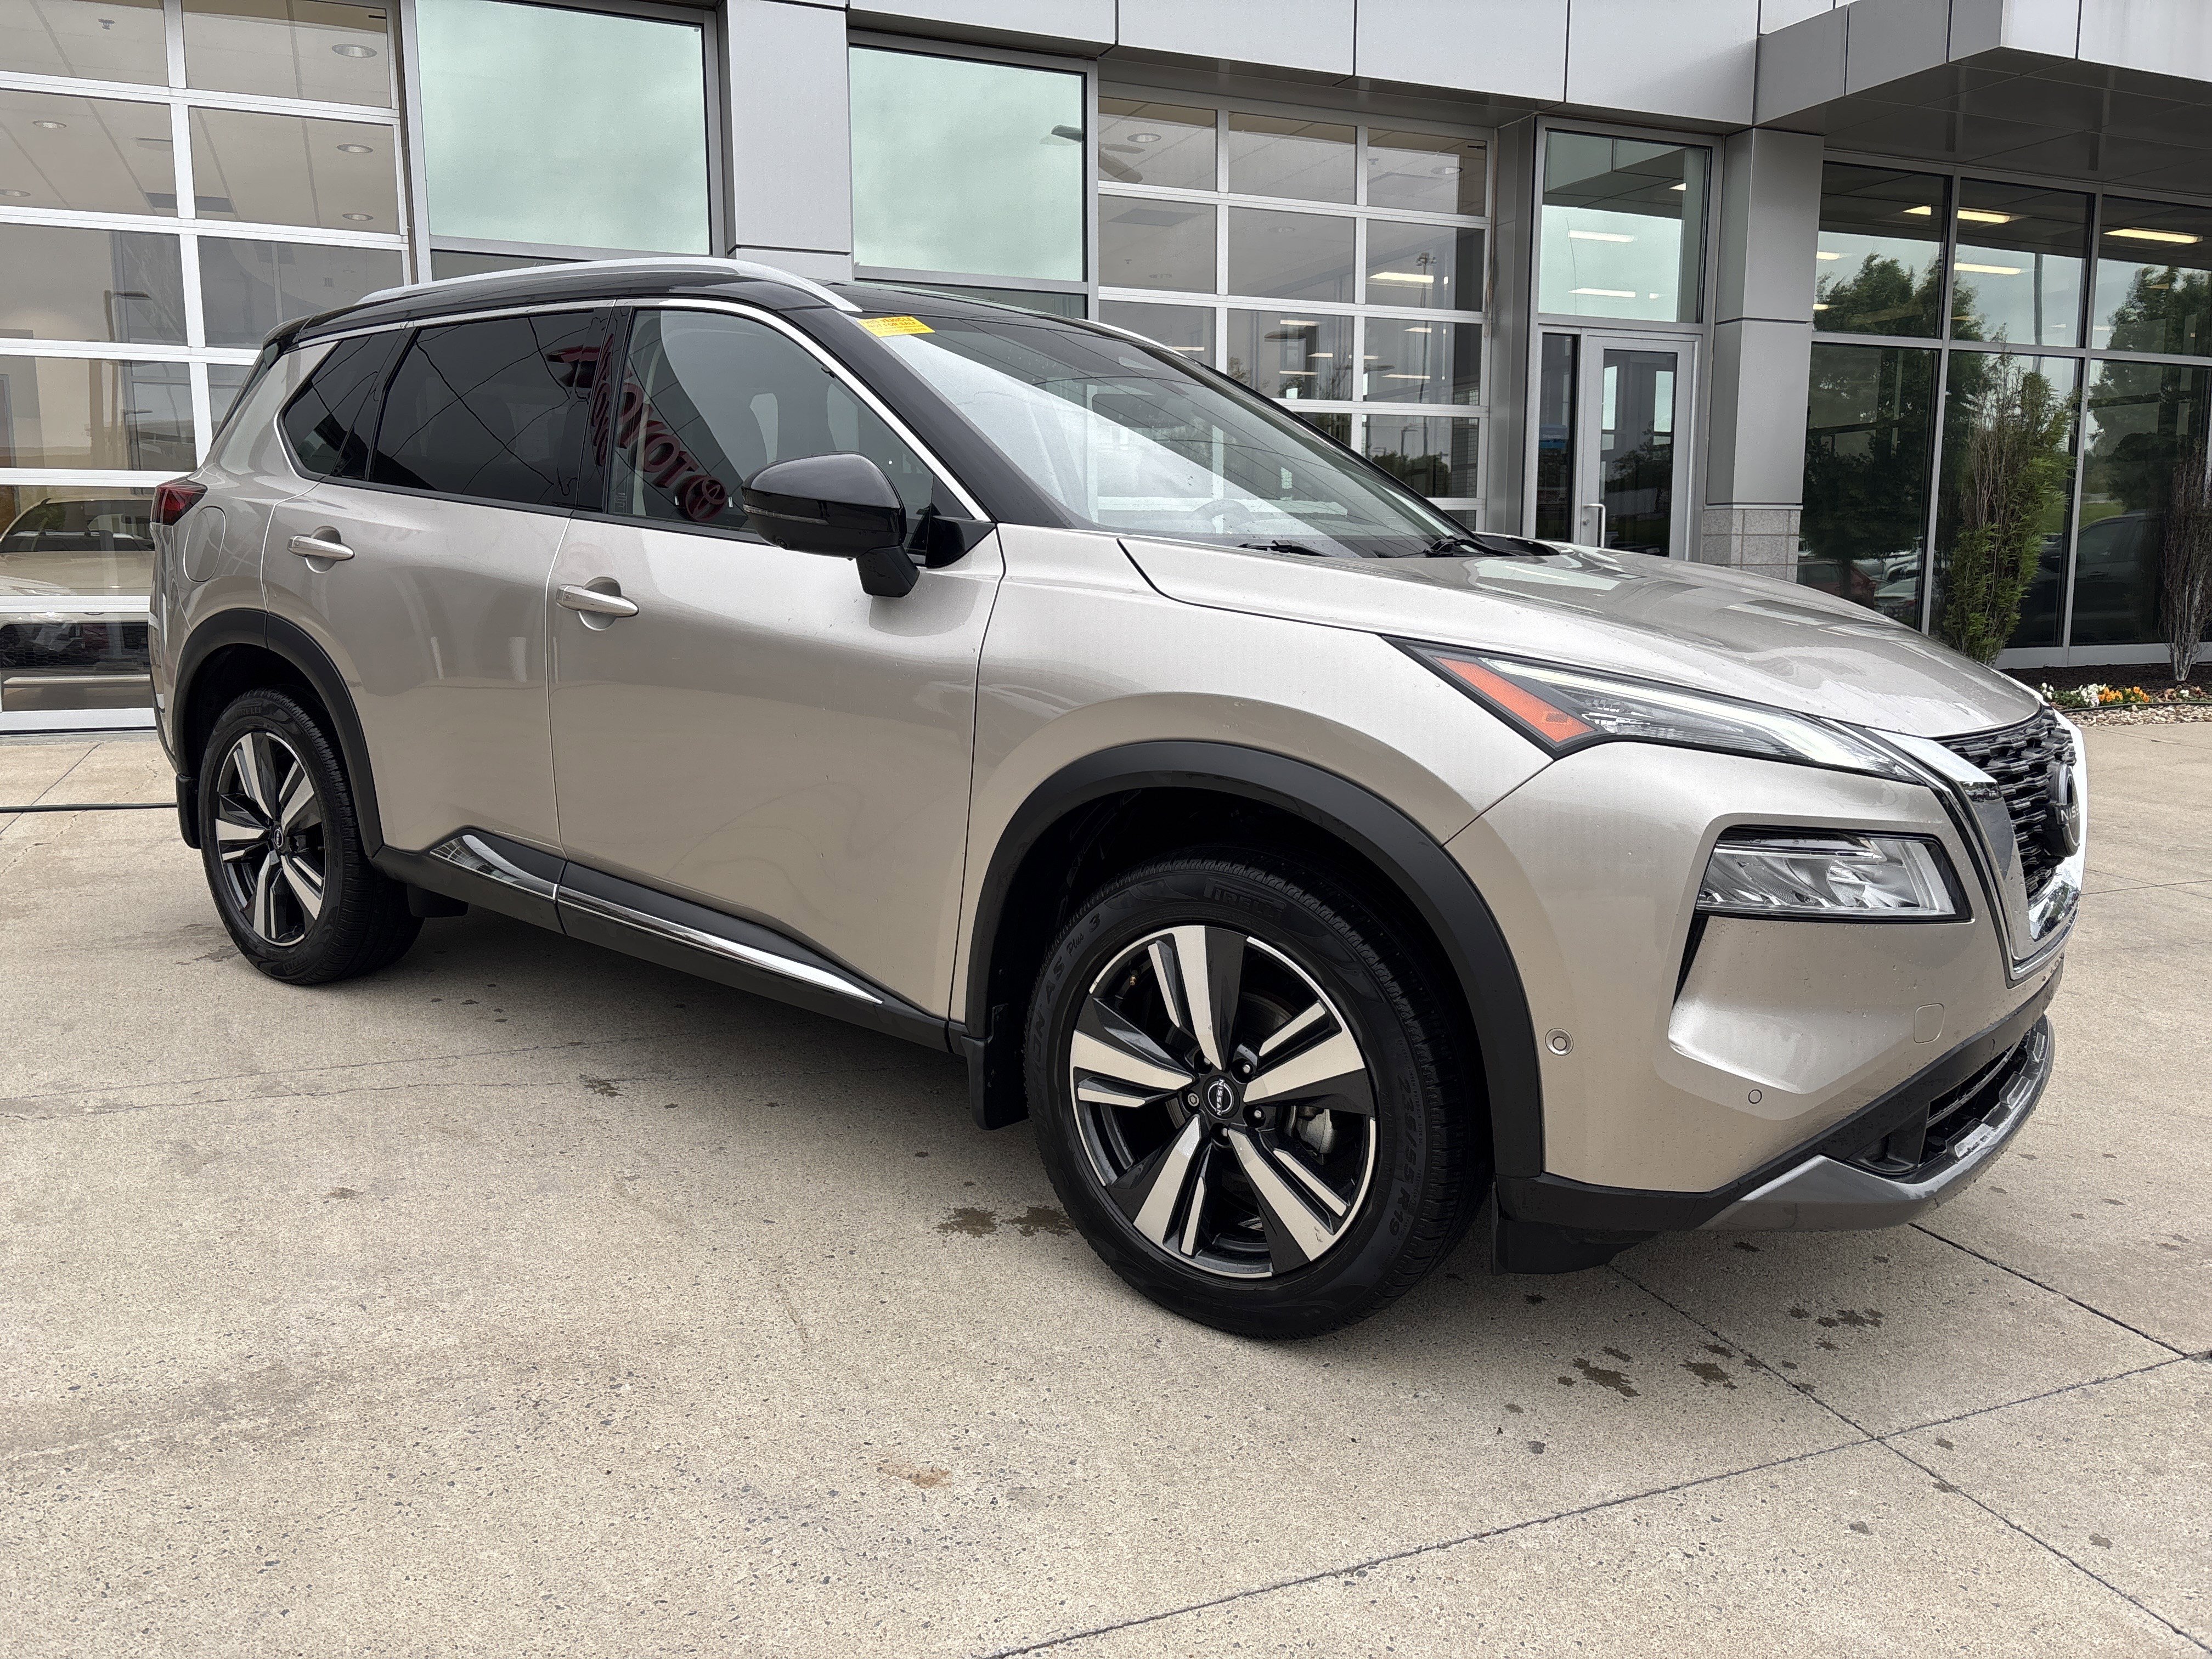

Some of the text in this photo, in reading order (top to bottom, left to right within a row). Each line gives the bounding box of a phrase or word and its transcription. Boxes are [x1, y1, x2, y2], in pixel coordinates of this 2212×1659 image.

[2060, 803, 2079, 822] NISS
[1203, 877, 1287, 922] PIRELLI
[1066, 933, 1085, 957] Plus
[1089, 912, 1101, 933] 3
[1216, 1078, 1225, 1116] NISSAN
[1389, 1187, 1411, 1237] R19
